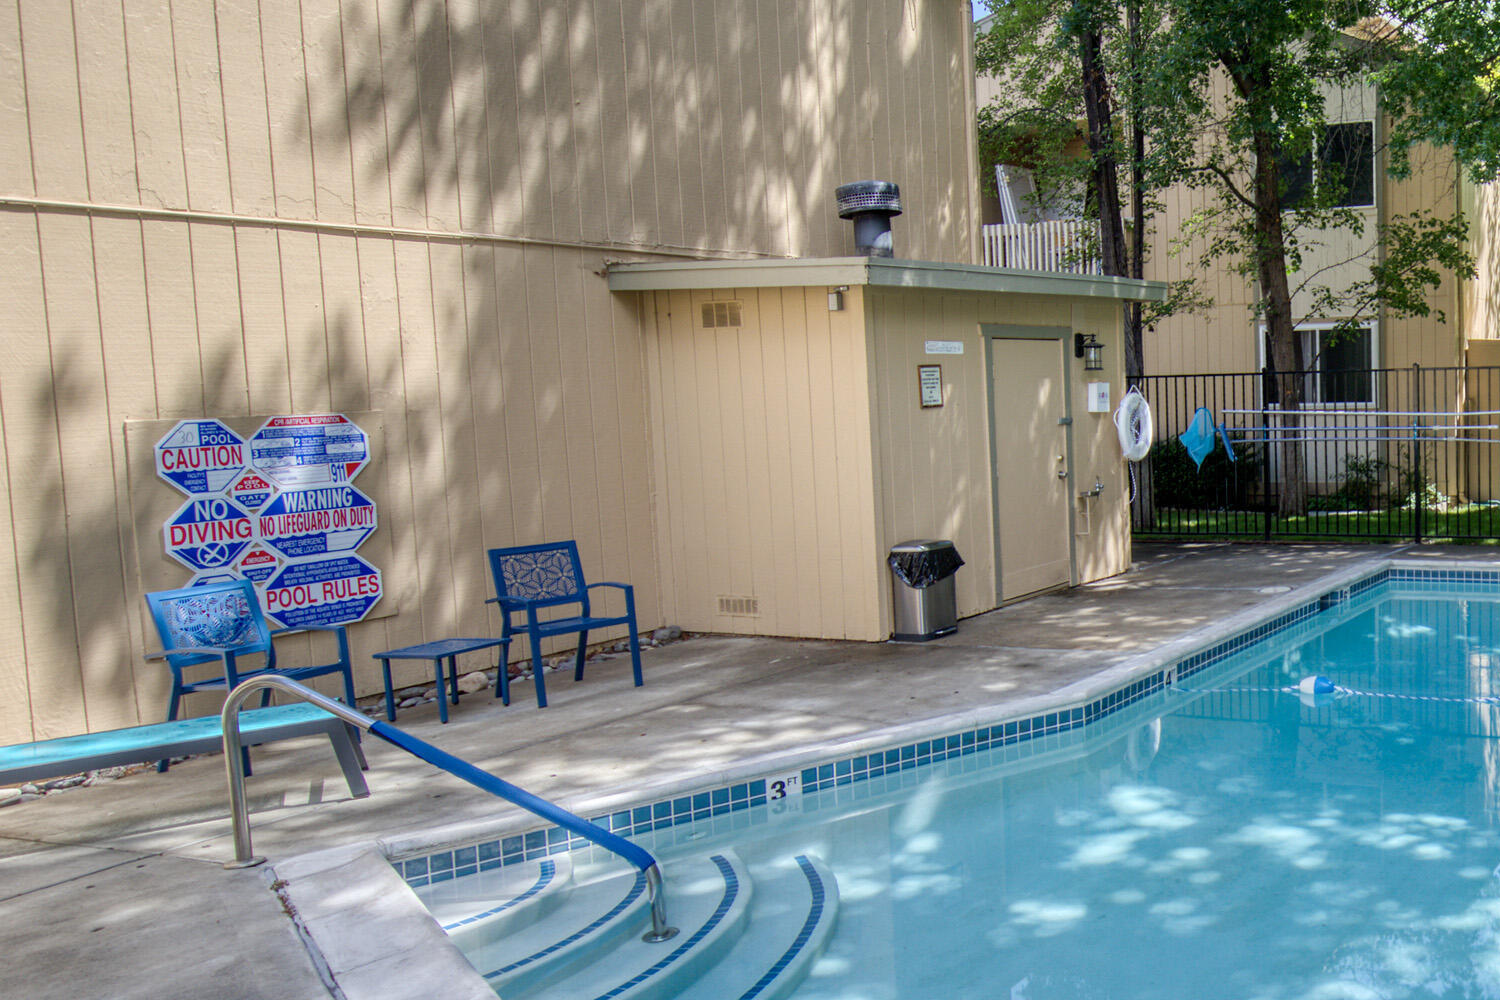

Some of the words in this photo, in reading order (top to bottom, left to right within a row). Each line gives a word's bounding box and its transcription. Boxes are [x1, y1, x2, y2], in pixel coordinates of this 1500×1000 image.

[201, 434, 234, 445] POOL
[295, 438, 301, 447] 2
[162, 445, 243, 470] CAUTION
[253, 450, 259, 458] 3
[331, 464, 347, 483] 911
[240, 493, 266, 501] GATE
[282, 487, 353, 513] WARNING
[194, 500, 228, 521] NO
[260, 516, 275, 537] NO
[278, 510, 330, 535] LIFEGUARD
[333, 508, 347, 528] ON
[350, 505, 374, 526] DUTY
[170, 518, 252, 546] DIVING
[266, 585, 318, 610] POOL
[322, 575, 380, 600] RULES
[1165, 670, 1171, 685] 4
[770, 780, 787, 800] 3
[787, 776, 798, 786] FT
